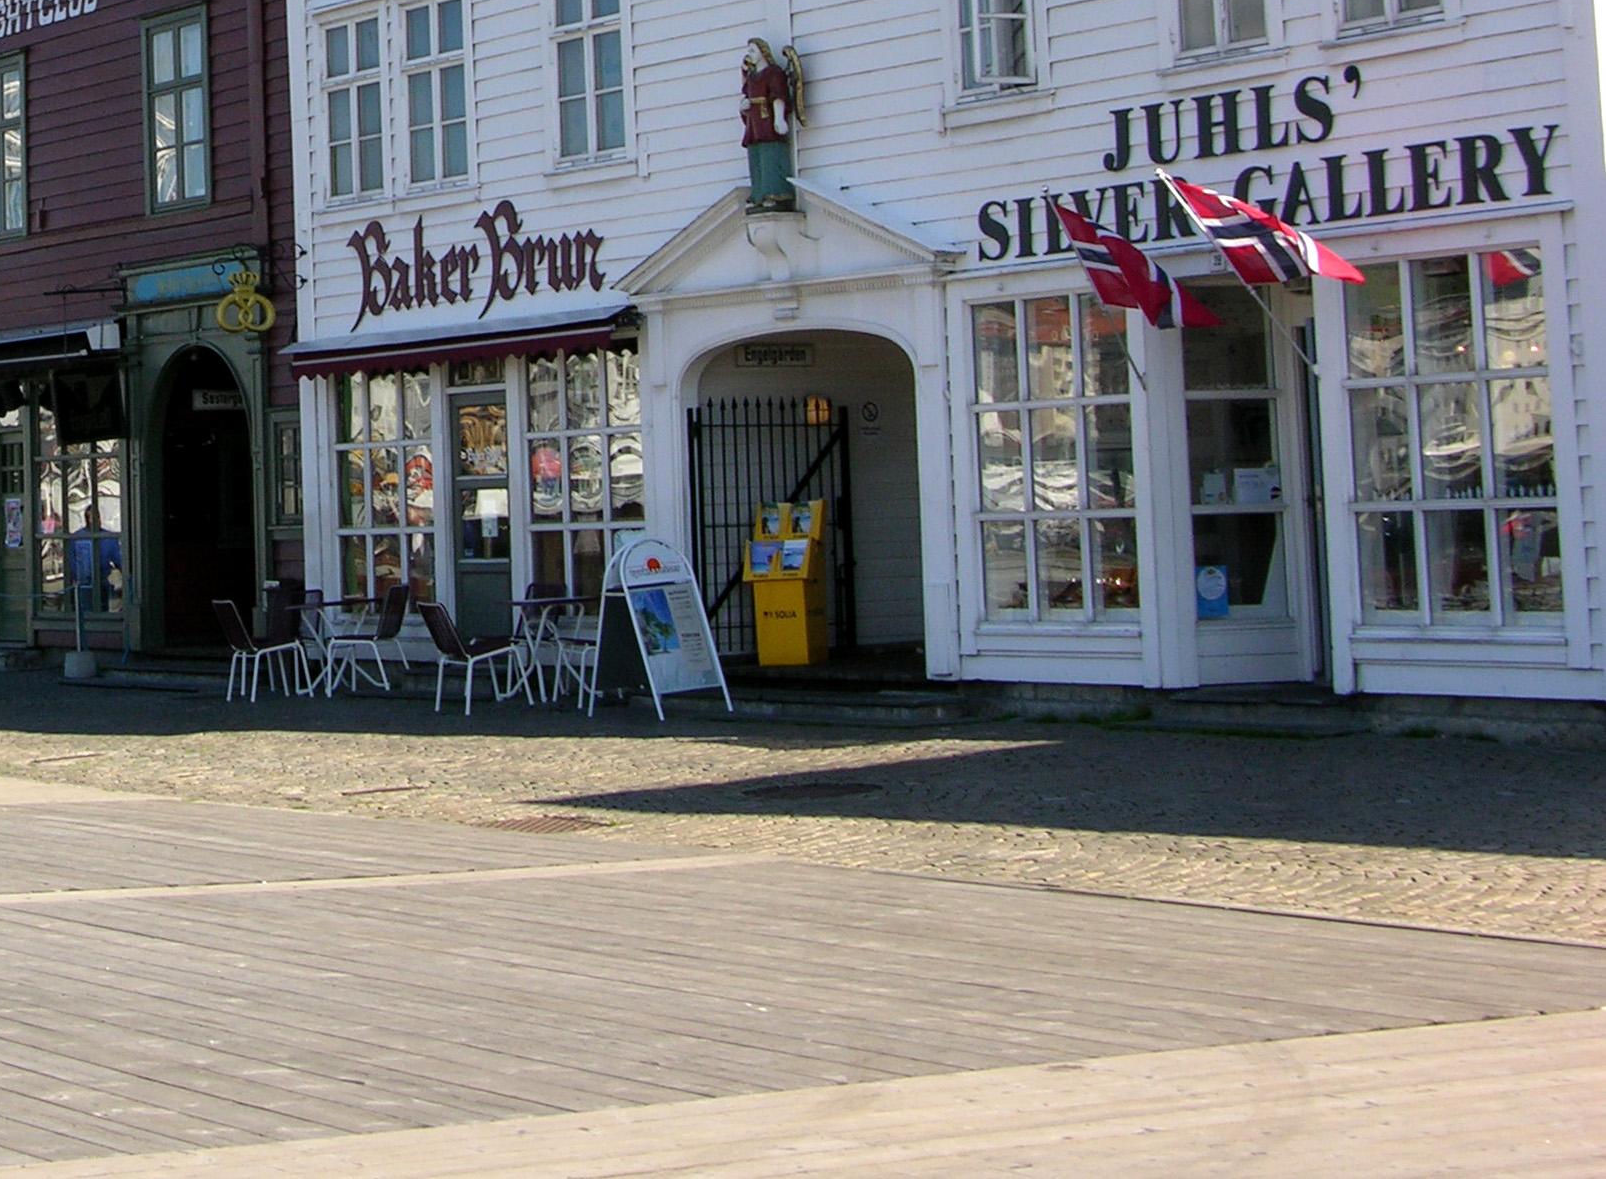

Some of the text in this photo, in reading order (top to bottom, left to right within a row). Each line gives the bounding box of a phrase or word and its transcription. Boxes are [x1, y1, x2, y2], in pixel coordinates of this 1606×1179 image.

[977, 124, 1559, 262] SILVER GALLERY
[346, 199, 607, 333] Baker Brun
